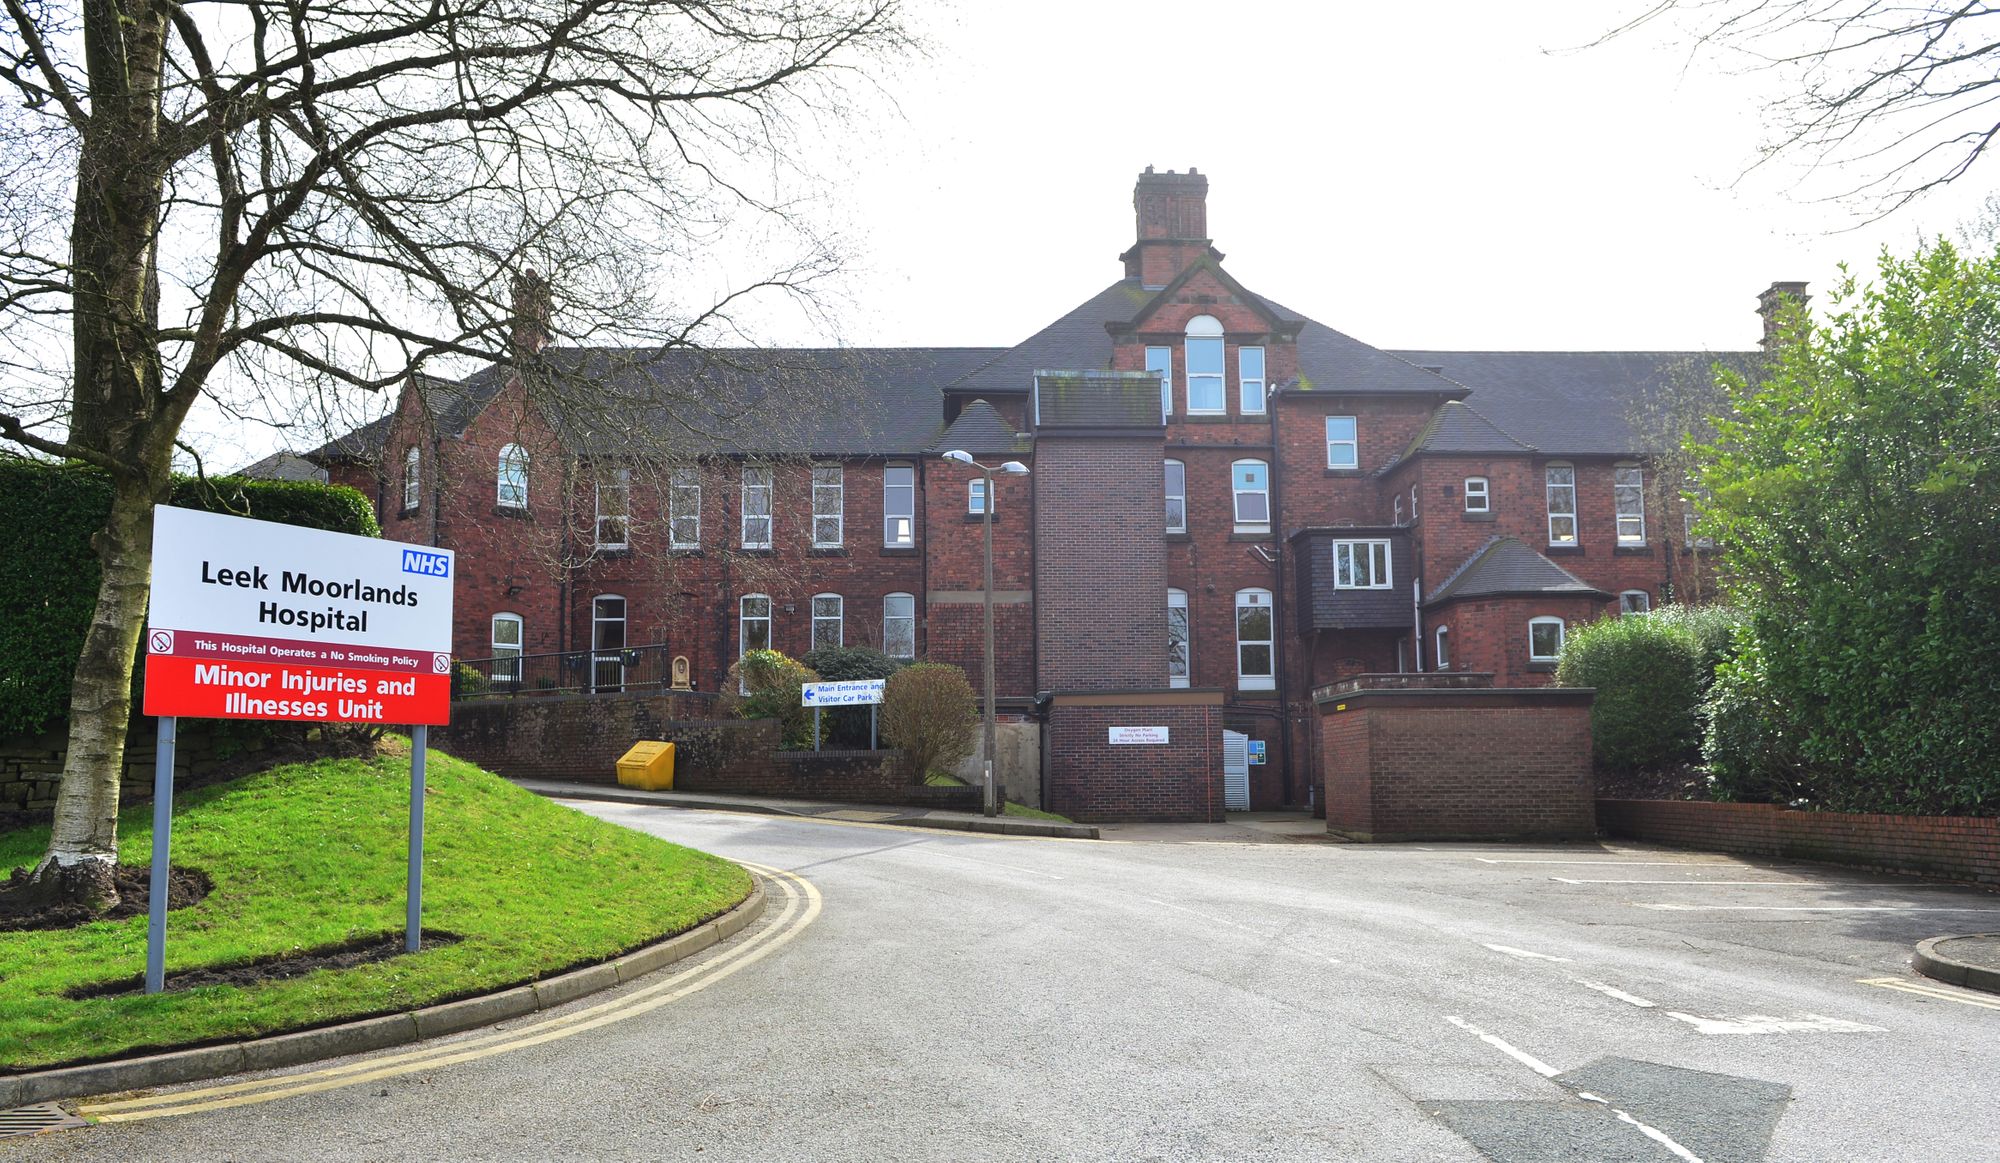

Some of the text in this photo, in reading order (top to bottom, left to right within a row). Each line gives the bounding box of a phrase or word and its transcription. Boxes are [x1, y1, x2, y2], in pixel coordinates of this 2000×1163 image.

[403, 552, 447, 575] NHS
[201, 560, 418, 607] Leek Moorlands
[258, 601, 367, 633] Hospital
[194, 640, 419, 668] This Hospital Operates a No Smoking Policy
[194, 664, 416, 696] Minor Injuries and
[837, 684, 868, 692] Entrance
[225, 692, 383, 720] Illnesses Unit
